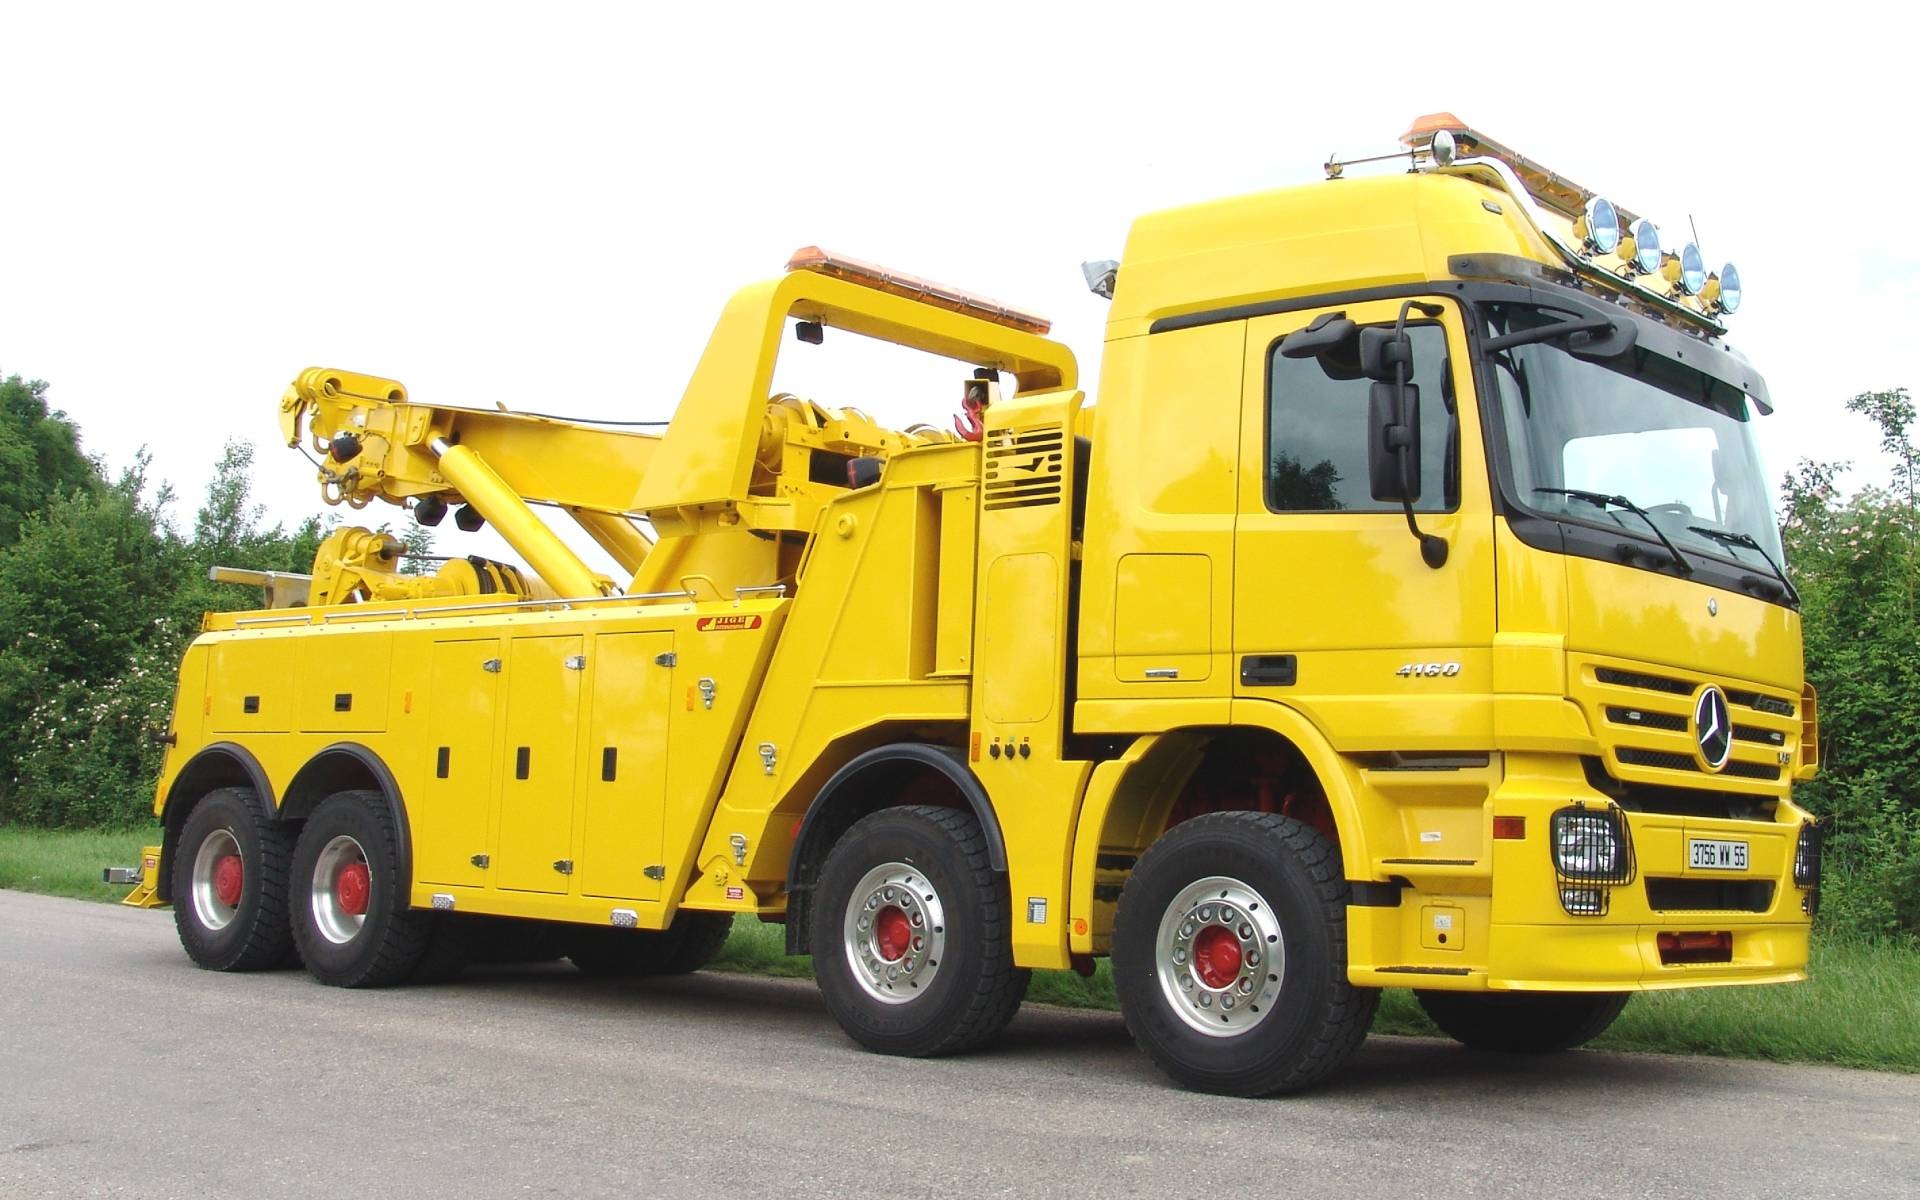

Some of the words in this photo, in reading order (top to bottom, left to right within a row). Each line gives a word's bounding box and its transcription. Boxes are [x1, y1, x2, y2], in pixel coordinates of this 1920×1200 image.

[1395, 662, 1460, 678] 4160
[1693, 843, 1716, 865] 3756
[1734, 846, 1745, 866] 55
